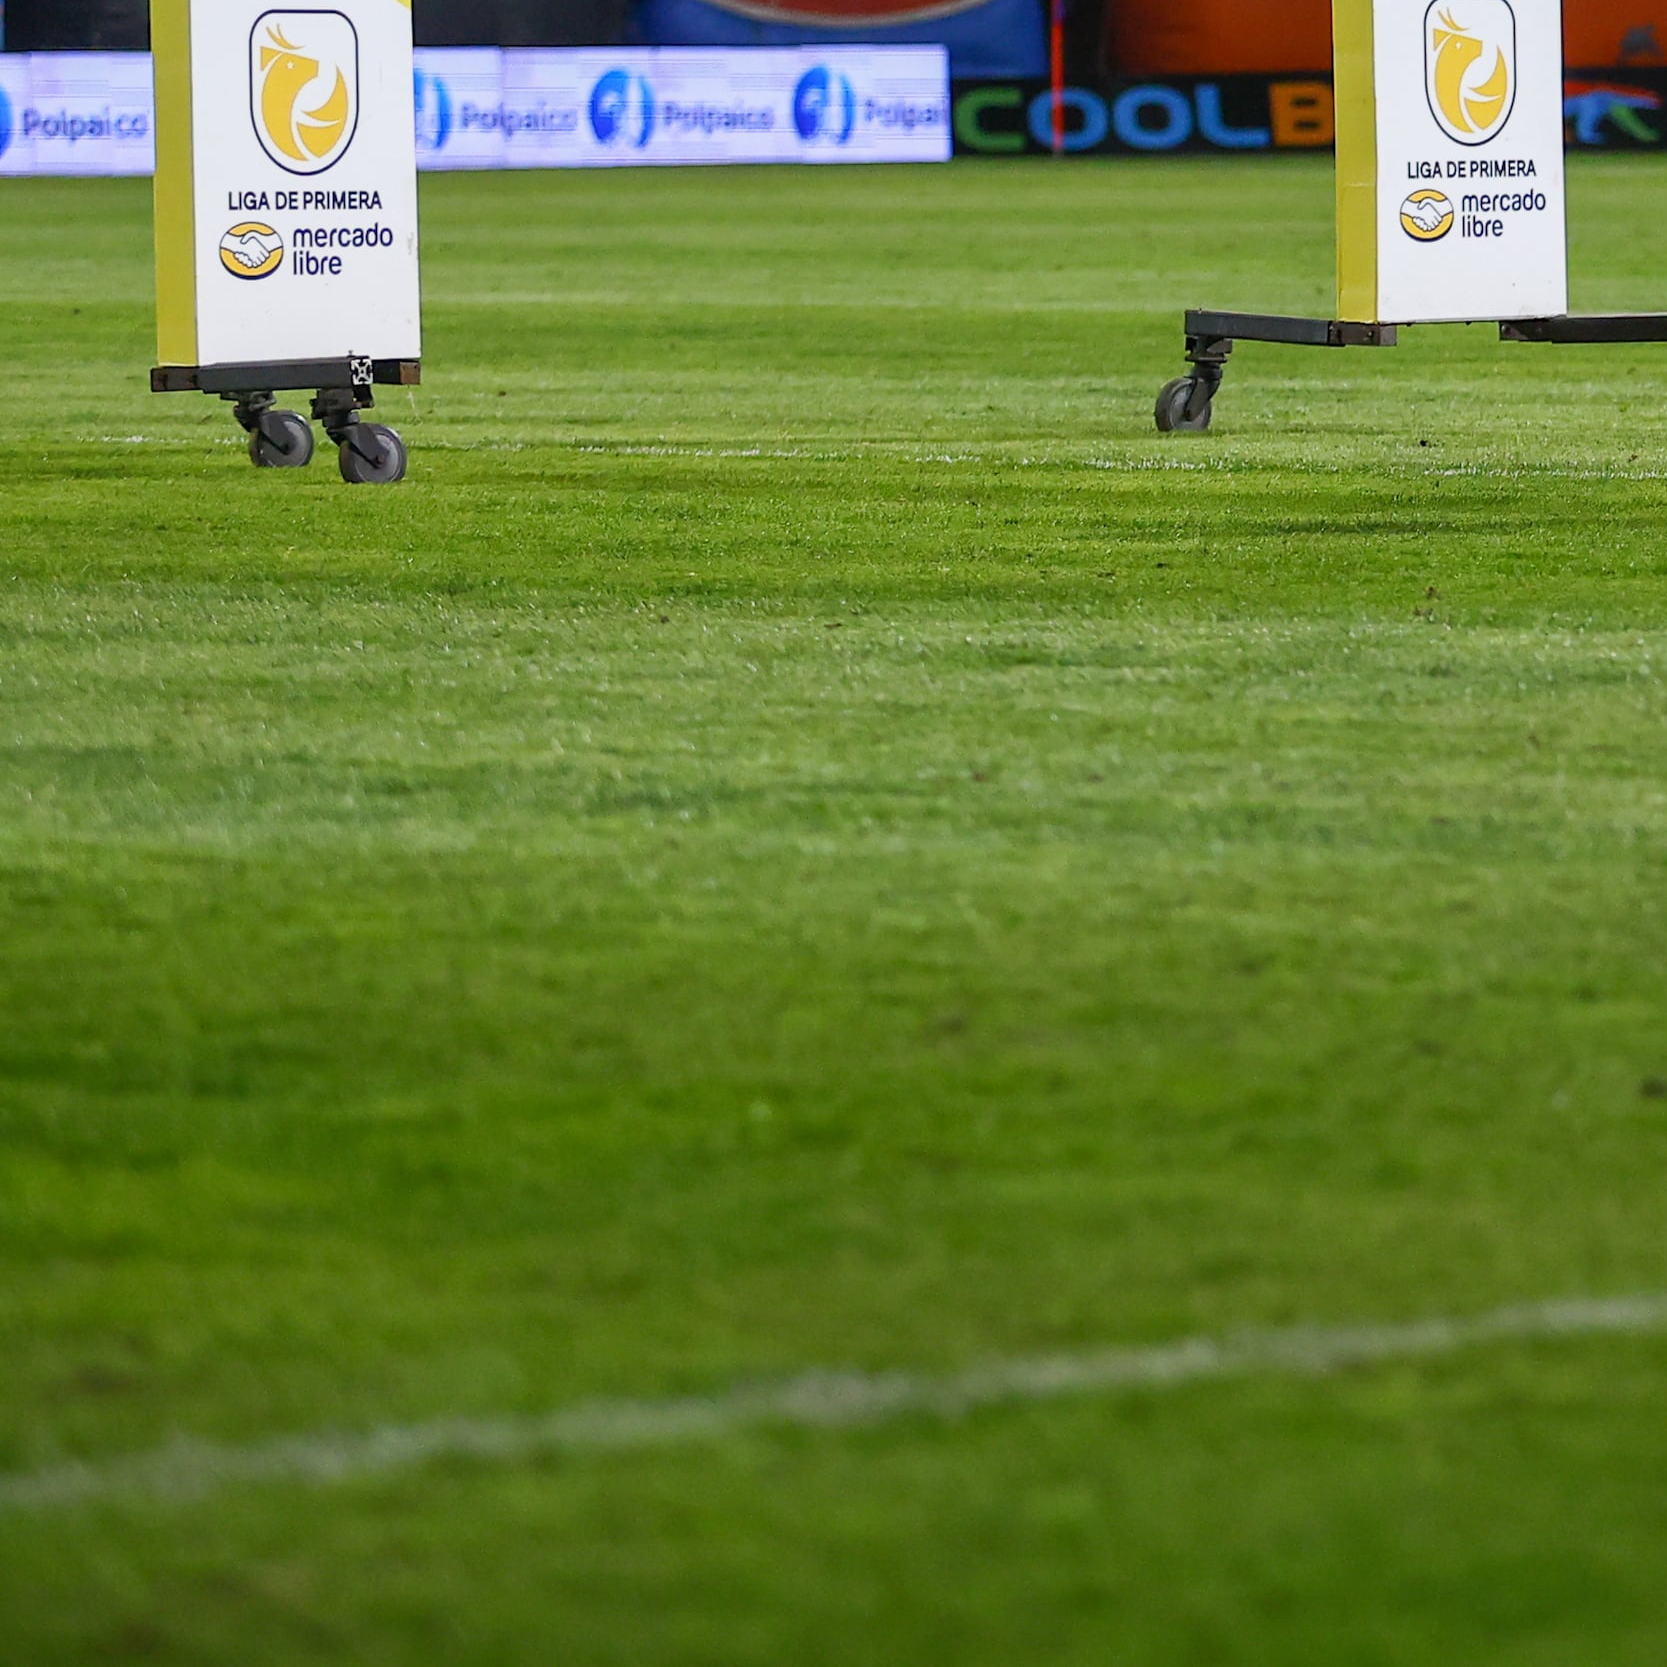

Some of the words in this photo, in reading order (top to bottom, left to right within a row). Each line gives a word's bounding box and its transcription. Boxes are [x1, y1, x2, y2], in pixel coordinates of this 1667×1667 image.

[952, 81, 1336, 152] COOLB
[1407, 161, 1443, 180] LIGA
[1446, 161, 1467, 179] DE
[1469, 158, 1537, 179] PRIMERA
[227, 190, 271, 211] LIGA
[275, 190, 299, 211] DE
[302, 190, 383, 211] PRIMERA
[1461, 187, 1546, 212] mercado
[292, 222, 394, 248] mercado
[1461, 215, 1504, 238] libre
[292, 250, 343, 276] libre
